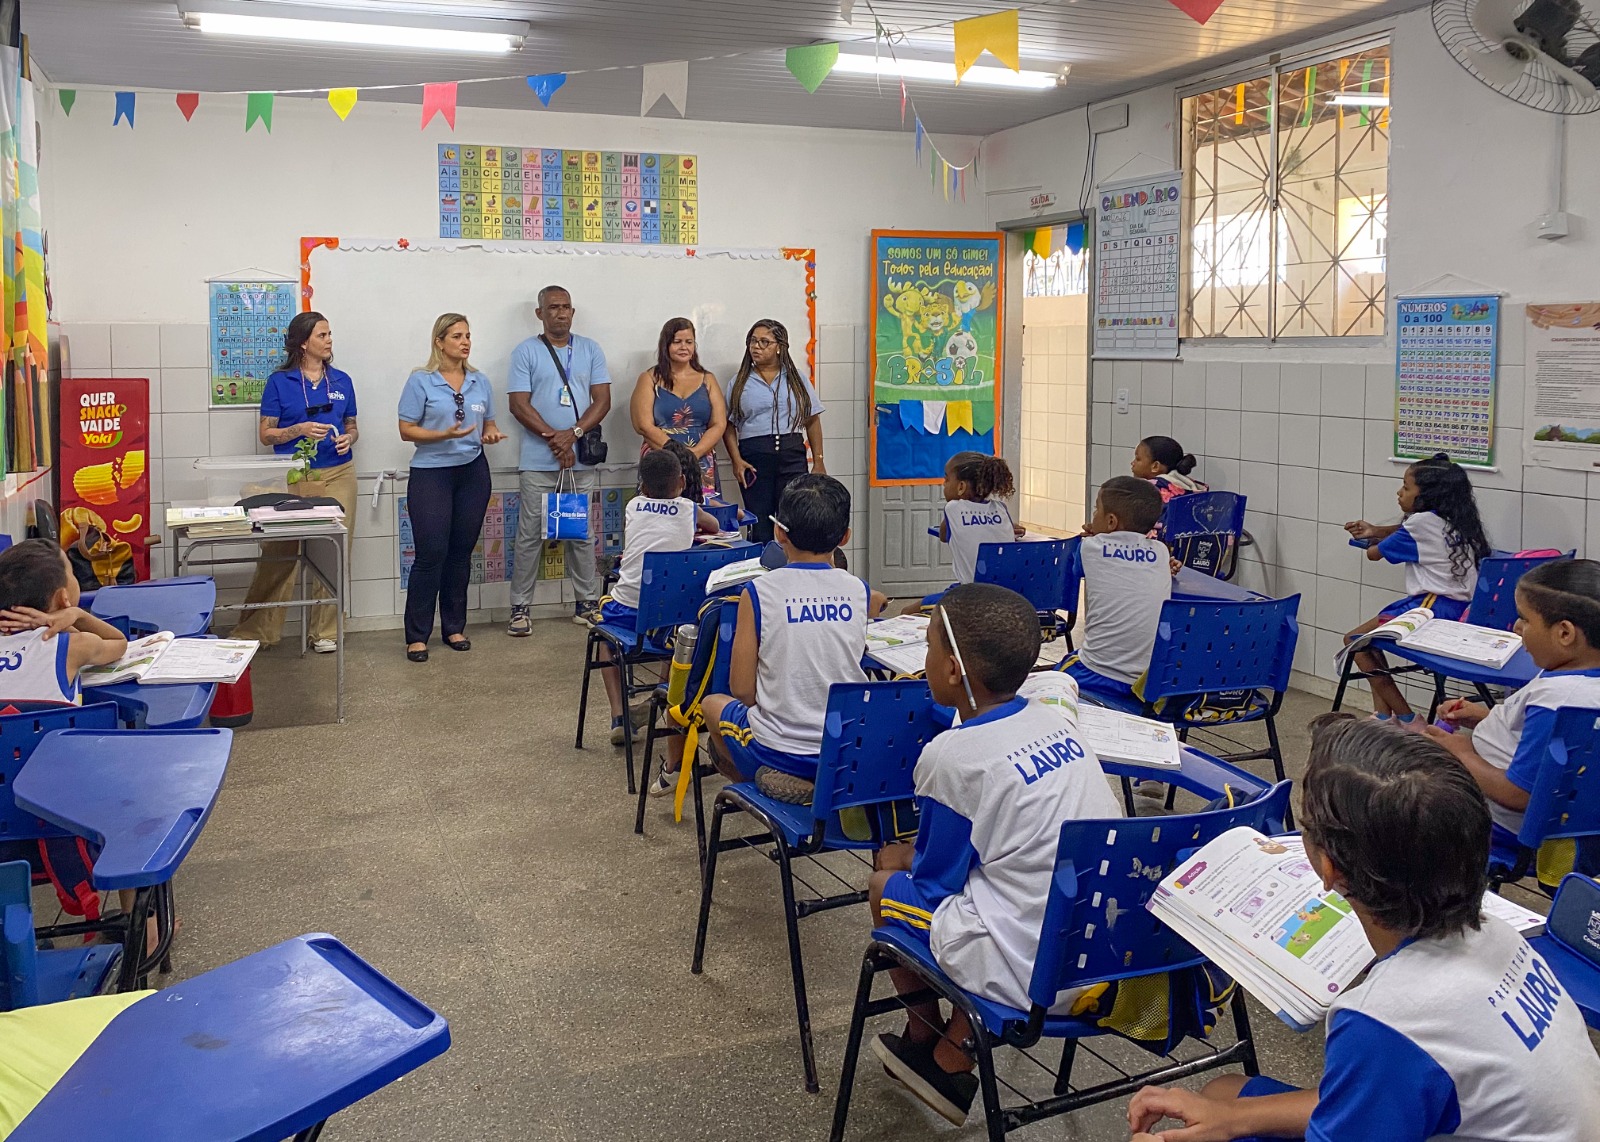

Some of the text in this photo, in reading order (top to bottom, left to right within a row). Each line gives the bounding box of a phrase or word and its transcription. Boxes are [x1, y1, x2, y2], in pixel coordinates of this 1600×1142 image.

[1102, 186, 1178, 211] CALENDÁRIO
[883, 260, 914, 276] Todos
[919, 262, 939, 277] pela
[1401, 302, 1447, 312] NÚMEROS
[81, 392, 115, 406] QUER
[80, 404, 127, 420] SNACK?
[80, 418, 120, 432] VAI DE
[83, 433, 112, 444] Yoki
[636, 502, 678, 515] LAURO
[962, 515, 1001, 526] LAURO
[1103, 545, 1157, 562] LAURO
[786, 604, 852, 623] LAURO
[1007, 728, 1069, 761] PREFEITURA
[1014, 738, 1084, 785] LAURO
[1488, 941, 1530, 1008] PREFEITURA
[1502, 958, 1561, 1052] LAURO
